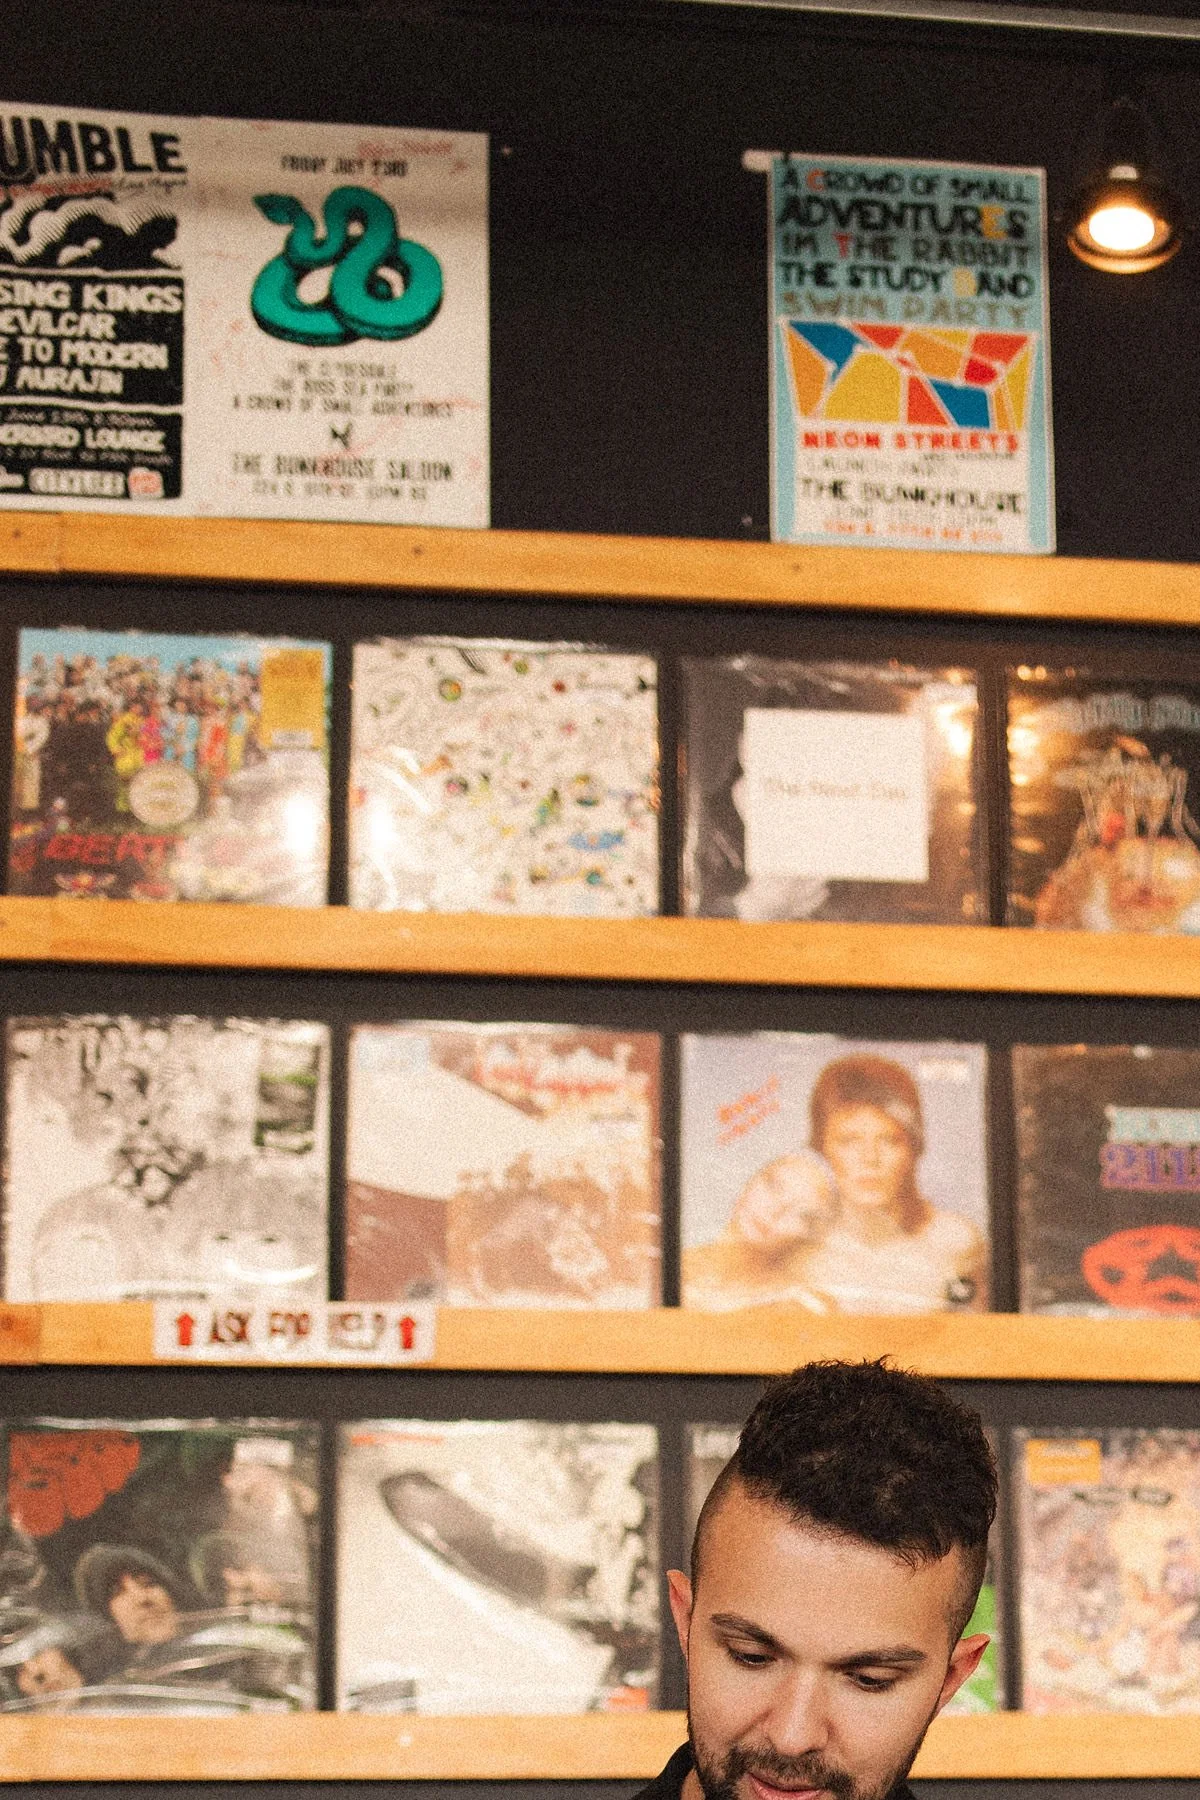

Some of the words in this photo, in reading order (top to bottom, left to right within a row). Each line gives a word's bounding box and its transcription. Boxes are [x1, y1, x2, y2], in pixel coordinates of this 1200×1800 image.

[782, 164, 800, 192] A
[806, 167, 904, 196] CROWD
[911, 173, 941, 196] OF
[949, 177, 1030, 203] SMALL
[777, 194, 1030, 241] ADVENTURES
[833, 231, 897, 262] THE
[910, 236, 1029, 270] RABBIT
[779, 260, 837, 290] THE
[848, 264, 946, 302] STUDY
[82, 283, 183, 314] KINGS
[903, 302, 1029, 327] PARTY
[17, 337, 54, 363] TO
[61, 339, 169, 369] MODERN
[803, 432, 880, 450] NEON
[896, 433, 1019, 454] STREETS
[802, 477, 848, 501] THE
